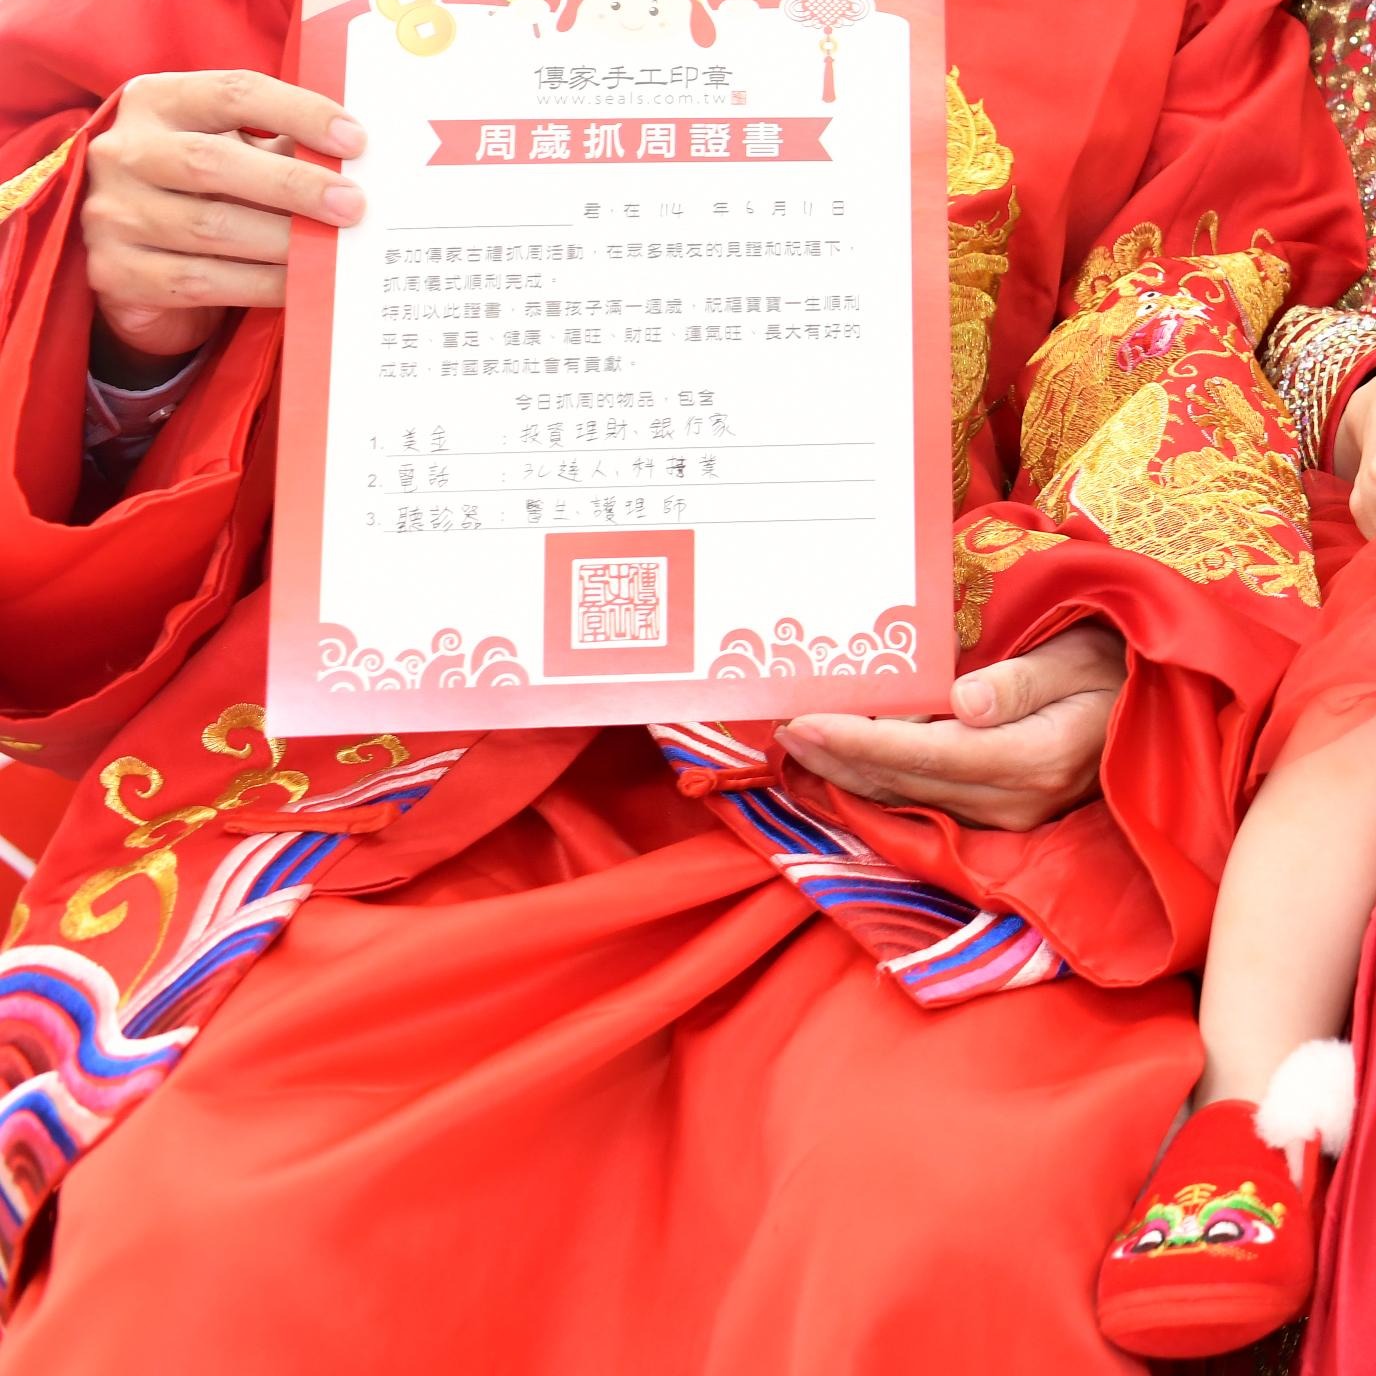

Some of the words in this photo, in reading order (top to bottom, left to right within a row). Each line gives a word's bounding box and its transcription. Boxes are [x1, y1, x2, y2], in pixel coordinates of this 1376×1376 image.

[533, 64, 734, 91] 傳家手工印章
[536, 91, 727, 106] www.seals.com.tw
[475, 122, 785, 161] 周歲抓周證書
[772, 201, 787, 216] 月
[832, 200, 845, 216] 日
